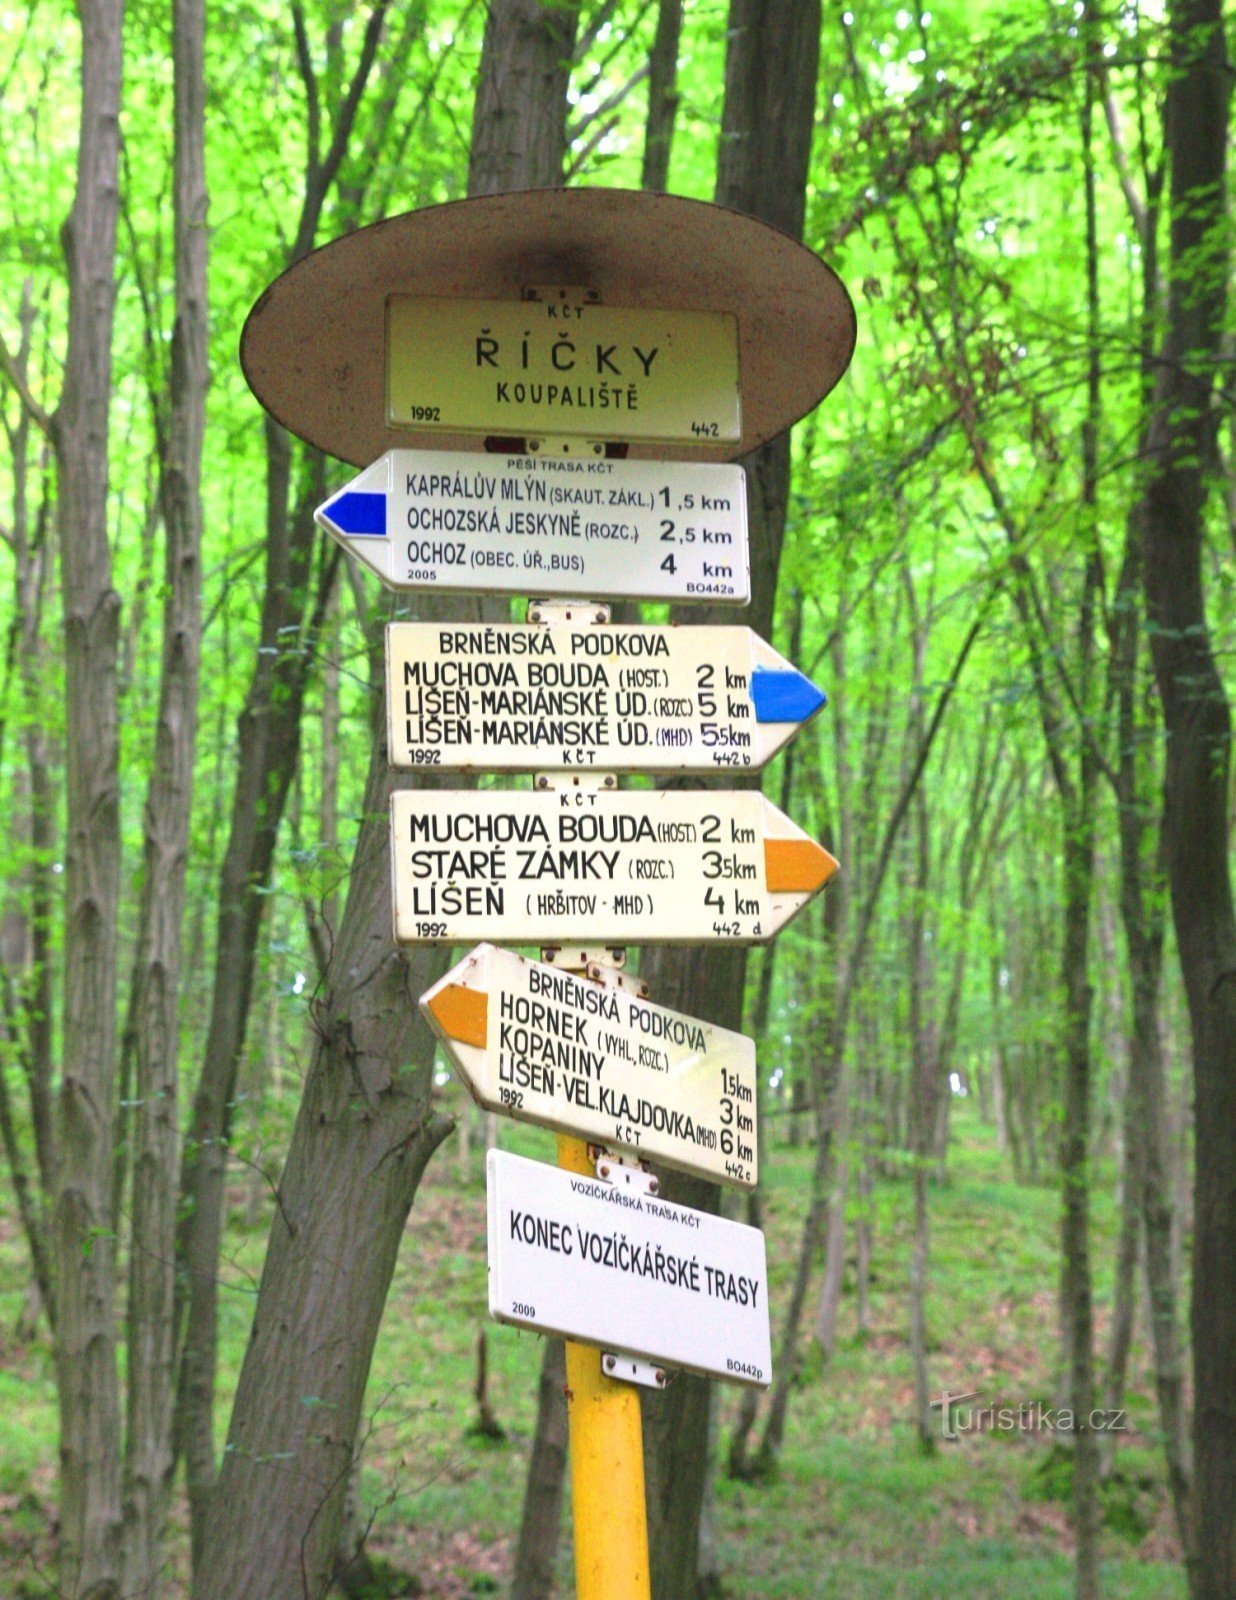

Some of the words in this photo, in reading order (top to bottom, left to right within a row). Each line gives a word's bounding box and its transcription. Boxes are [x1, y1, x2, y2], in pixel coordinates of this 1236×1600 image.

[548, 303, 585, 319] KČT
[475, 328, 659, 377] ŘÍČKY
[496, 382, 638, 410] KOUPALIŠTĚ
[411, 405, 441, 421] 1992
[691, 422, 719, 438] 442
[541, 461, 584, 472] TRASA
[406, 471, 496, 499] KAPRÁLŮV
[501, 474, 546, 501] MLÝN
[549, 487, 605, 506] (SKAUT.
[609, 487, 655, 511] ZÁKL.)
[701, 495, 731, 511] km
[407, 506, 500, 532] OCHOZSKÁ
[505, 511, 581, 537] JESKYNĚ
[585, 522, 639, 544] (ROZC.)
[702, 528, 733, 544] km
[407, 540, 466, 565] OCHOZ
[470, 550, 519, 569] (OBEC.
[660, 552, 678, 575] 4
[703, 562, 733, 578] km
[407, 569, 437, 580] 2005
[439, 627, 556, 655] BRNĚNSKÁ
[570, 633, 670, 657] PODKOVA
[404, 661, 519, 687] MUCHOVA
[527, 662, 609, 688] BOUDA
[619, 668, 669, 688] (HOST.)
[696, 663, 715, 688] 2
[725, 665, 747, 689] km
[698, 692, 717, 717] 5
[727, 694, 749, 718] km
[656, 727, 693, 747] (MHD)
[409, 749, 441, 764] 1992
[562, 749, 596, 764] KČT
[560, 792, 597, 807] KČT
[410, 814, 550, 843] MUCHOVA
[559, 814, 657, 843] BOUDA
[700, 814, 721, 843] 2
[731, 818, 755, 844] km
[411, 844, 507, 879] STARÉ
[516, 843, 620, 880] ZÁMKY
[628, 859, 675, 879] (ROZC.)
[413, 881, 505, 916] LÍŠEŇ
[704, 886, 725, 915] 4
[735, 888, 760, 915] km
[415, 922, 448, 937] 1992
[712, 921, 741, 936] 442
[752, 921, 762, 936] d
[500, 991, 588, 1046] HORNEK
[529, 968, 620, 1024] BRNĚNSKÁ
[629, 1004, 707, 1054] PODKOVA
[500, 1022, 605, 1081] KOPANINY
[719, 1097, 733, 1125] 3
[736, 1104, 752, 1133] km
[499, 1087, 524, 1109] 1992
[616, 1124, 641, 1146] KČT
[720, 1128, 733, 1155] 6
[737, 1134, 753, 1163] km
[725, 1160, 744, 1179] 442
[570, 1179, 643, 1211] VOZÍČKÁŘSKÁ
[646, 1202, 679, 1223] TRASA
[681, 1212, 701, 1229] KČT
[510, 1209, 573, 1255] KONEC
[577, 1227, 701, 1292] VOZÍČKÁŘSKÉ
[704, 1266, 759, 1308] TRASY
[512, 1301, 536, 1318] 2009
